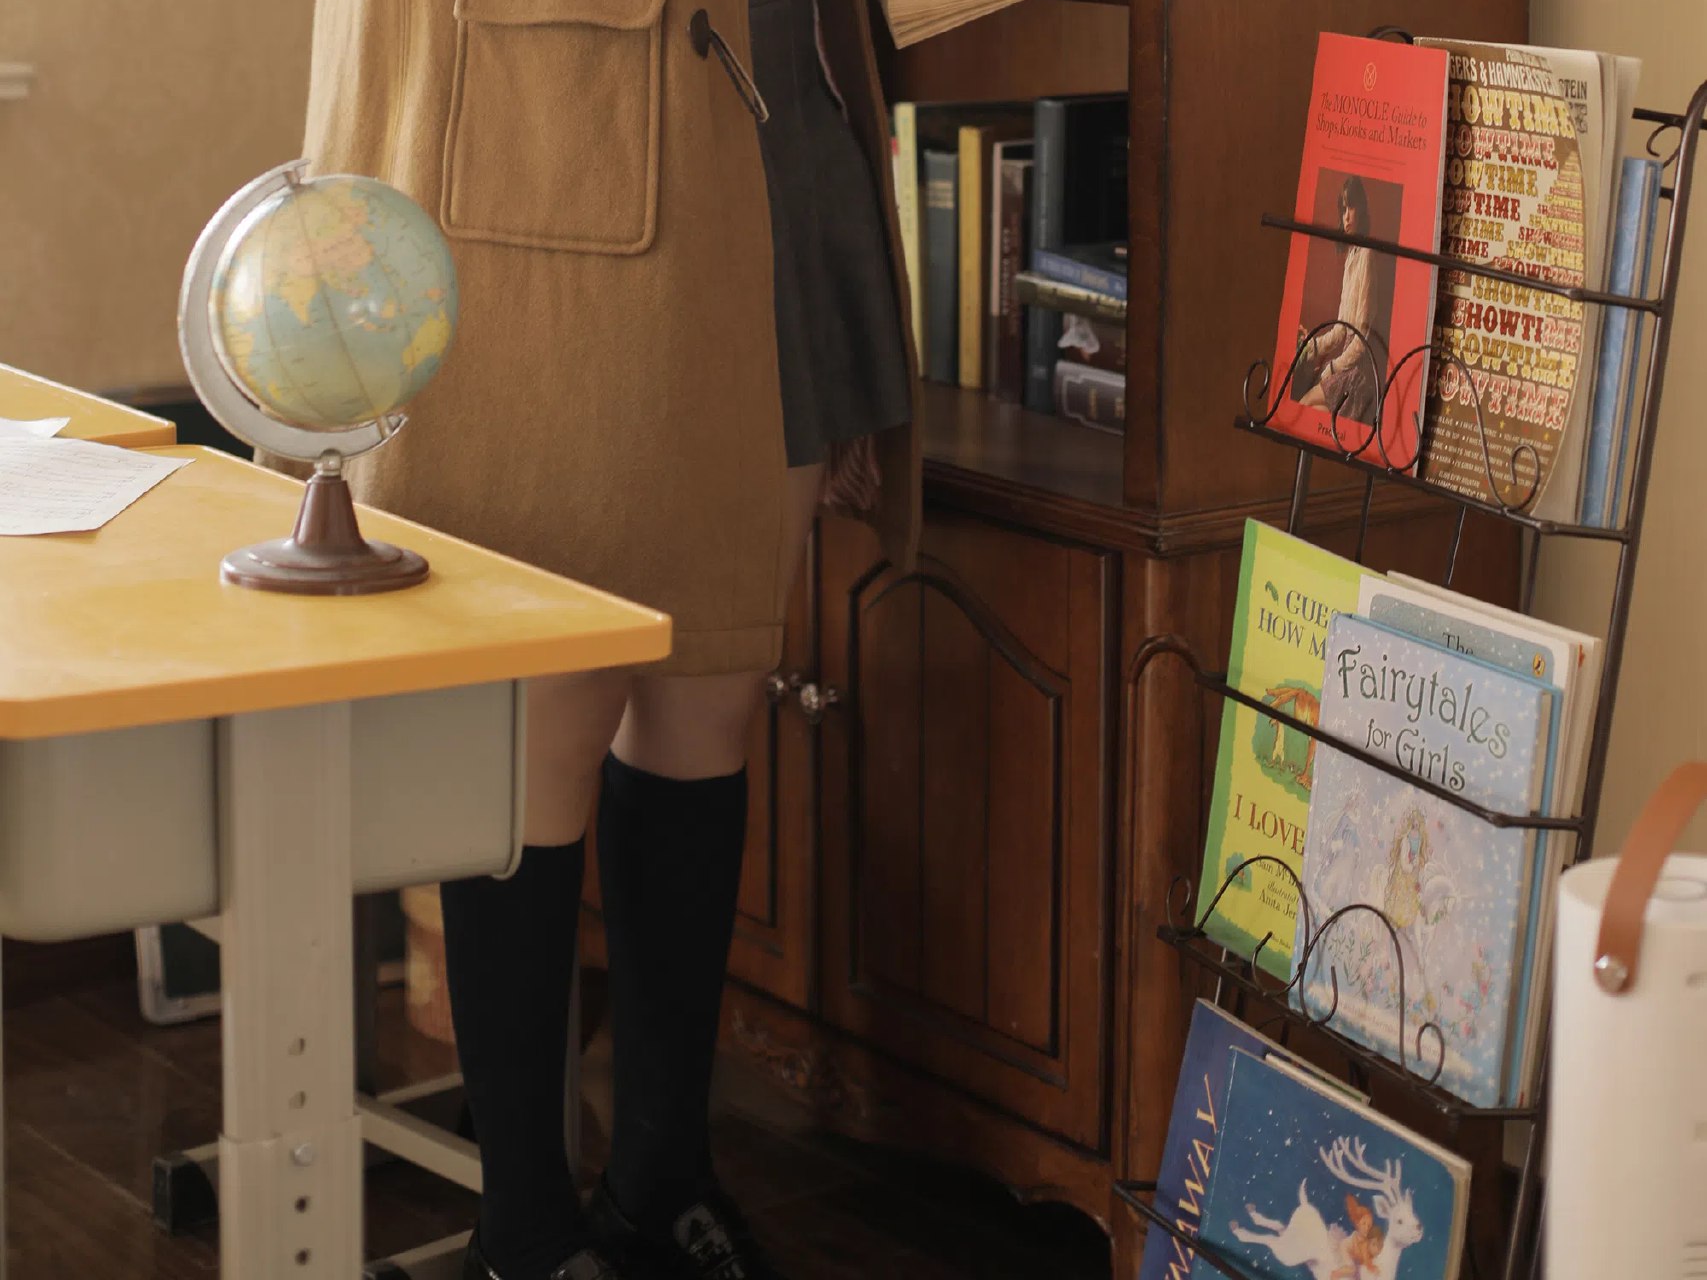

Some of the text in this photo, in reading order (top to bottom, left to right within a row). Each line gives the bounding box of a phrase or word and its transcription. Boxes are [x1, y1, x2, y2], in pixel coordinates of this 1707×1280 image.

[1479, 61, 1487, 87] &
[1321, 92, 1428, 129] The MONOCLE Guide to
[1340, 117, 1367, 140] Kiosks
[1368, 124, 1385, 143] and
[1387, 125, 1427, 151] Markets
[1451, 298, 1581, 353] SHOWTIME
[1257, 607, 1305, 649] HOW
[1337, 645, 1511, 760] Fairytales
[1365, 718, 1465, 792] for Girls
[1233, 793, 1306, 858] I LOVE
[1258, 888, 1281, 912] Anita
